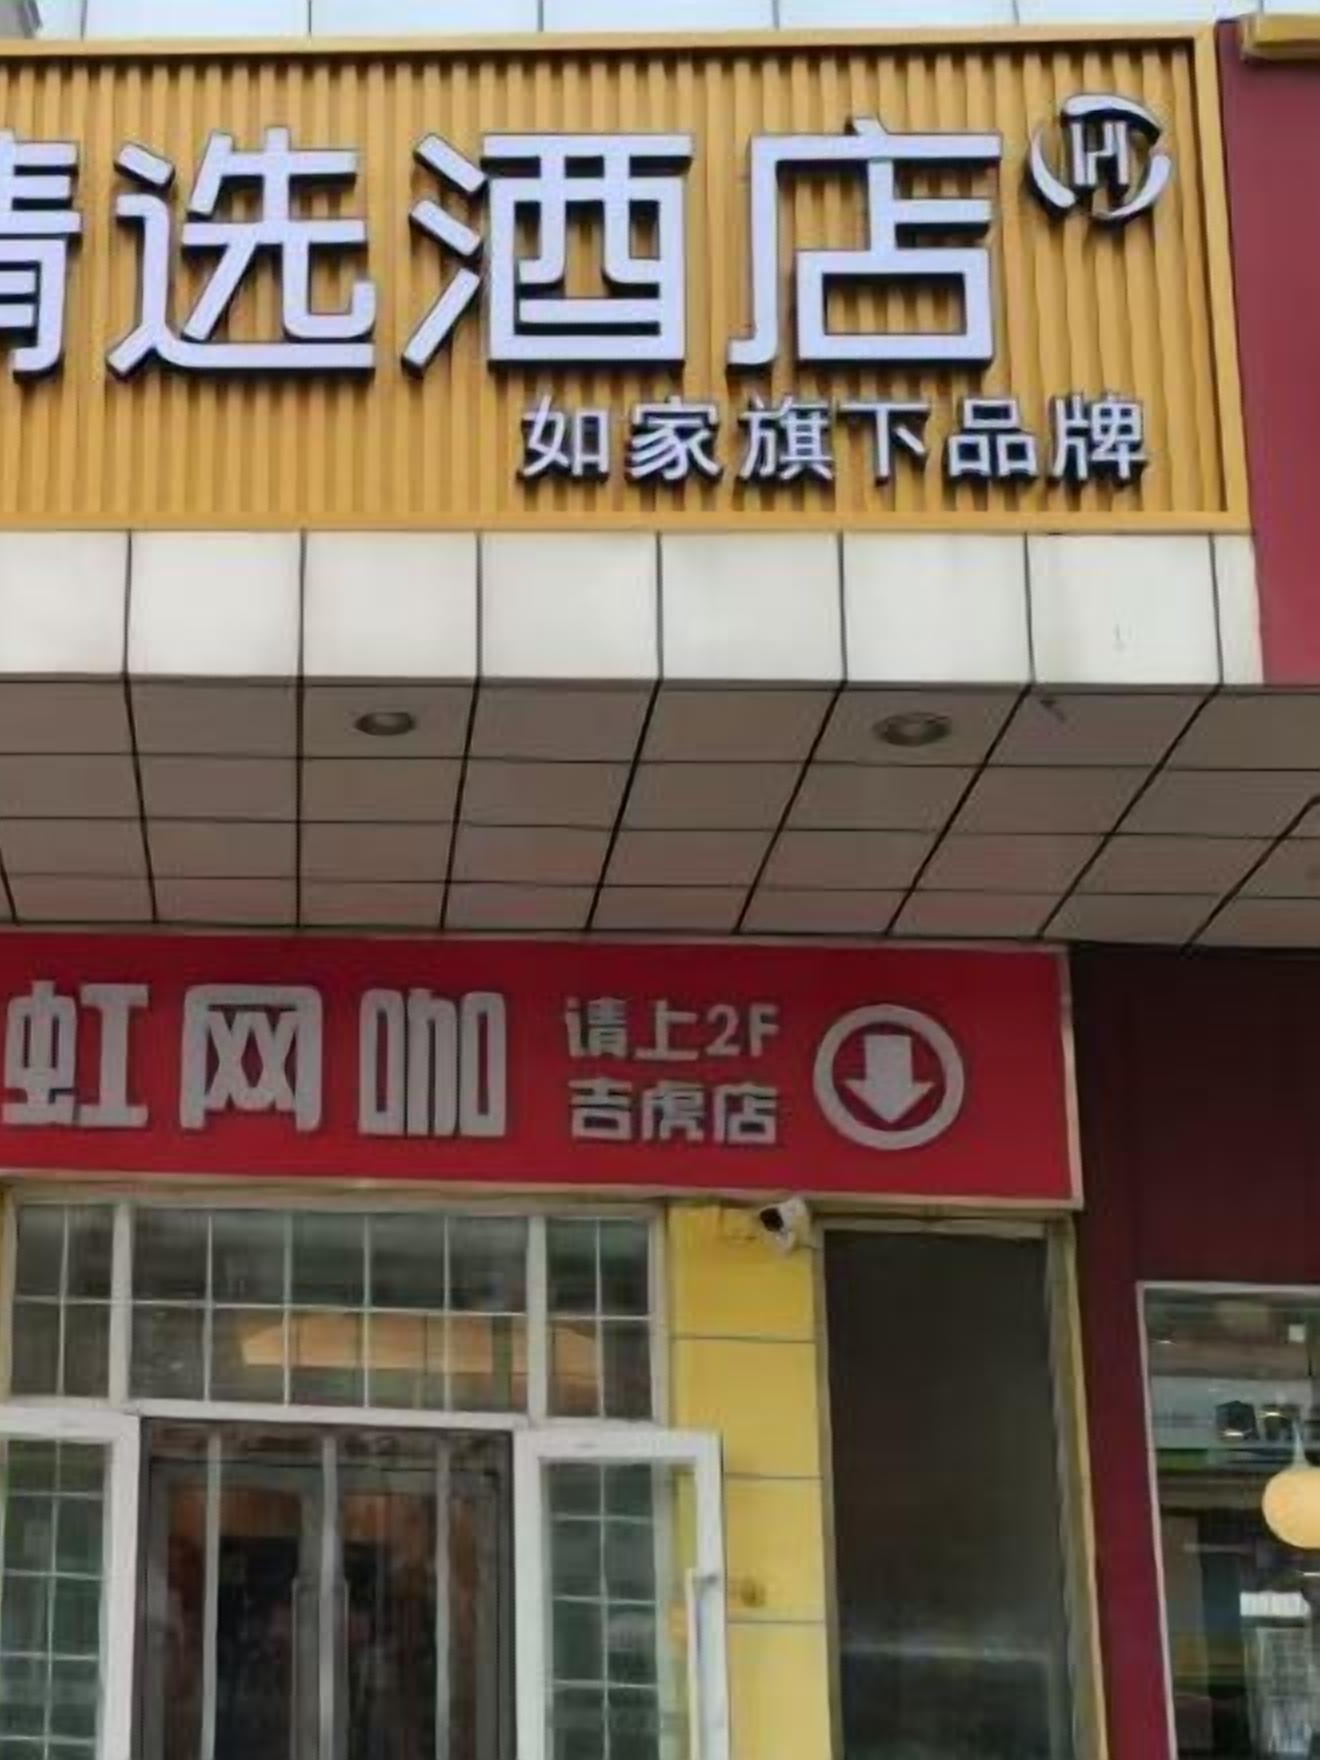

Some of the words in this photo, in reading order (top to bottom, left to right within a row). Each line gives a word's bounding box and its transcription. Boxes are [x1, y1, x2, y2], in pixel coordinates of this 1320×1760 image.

[518, 391, 1148, 486] 如家旗下品牌
[565, 996, 780, 1061] 请上2F
[567, 1075, 779, 1145] 吉虎店
